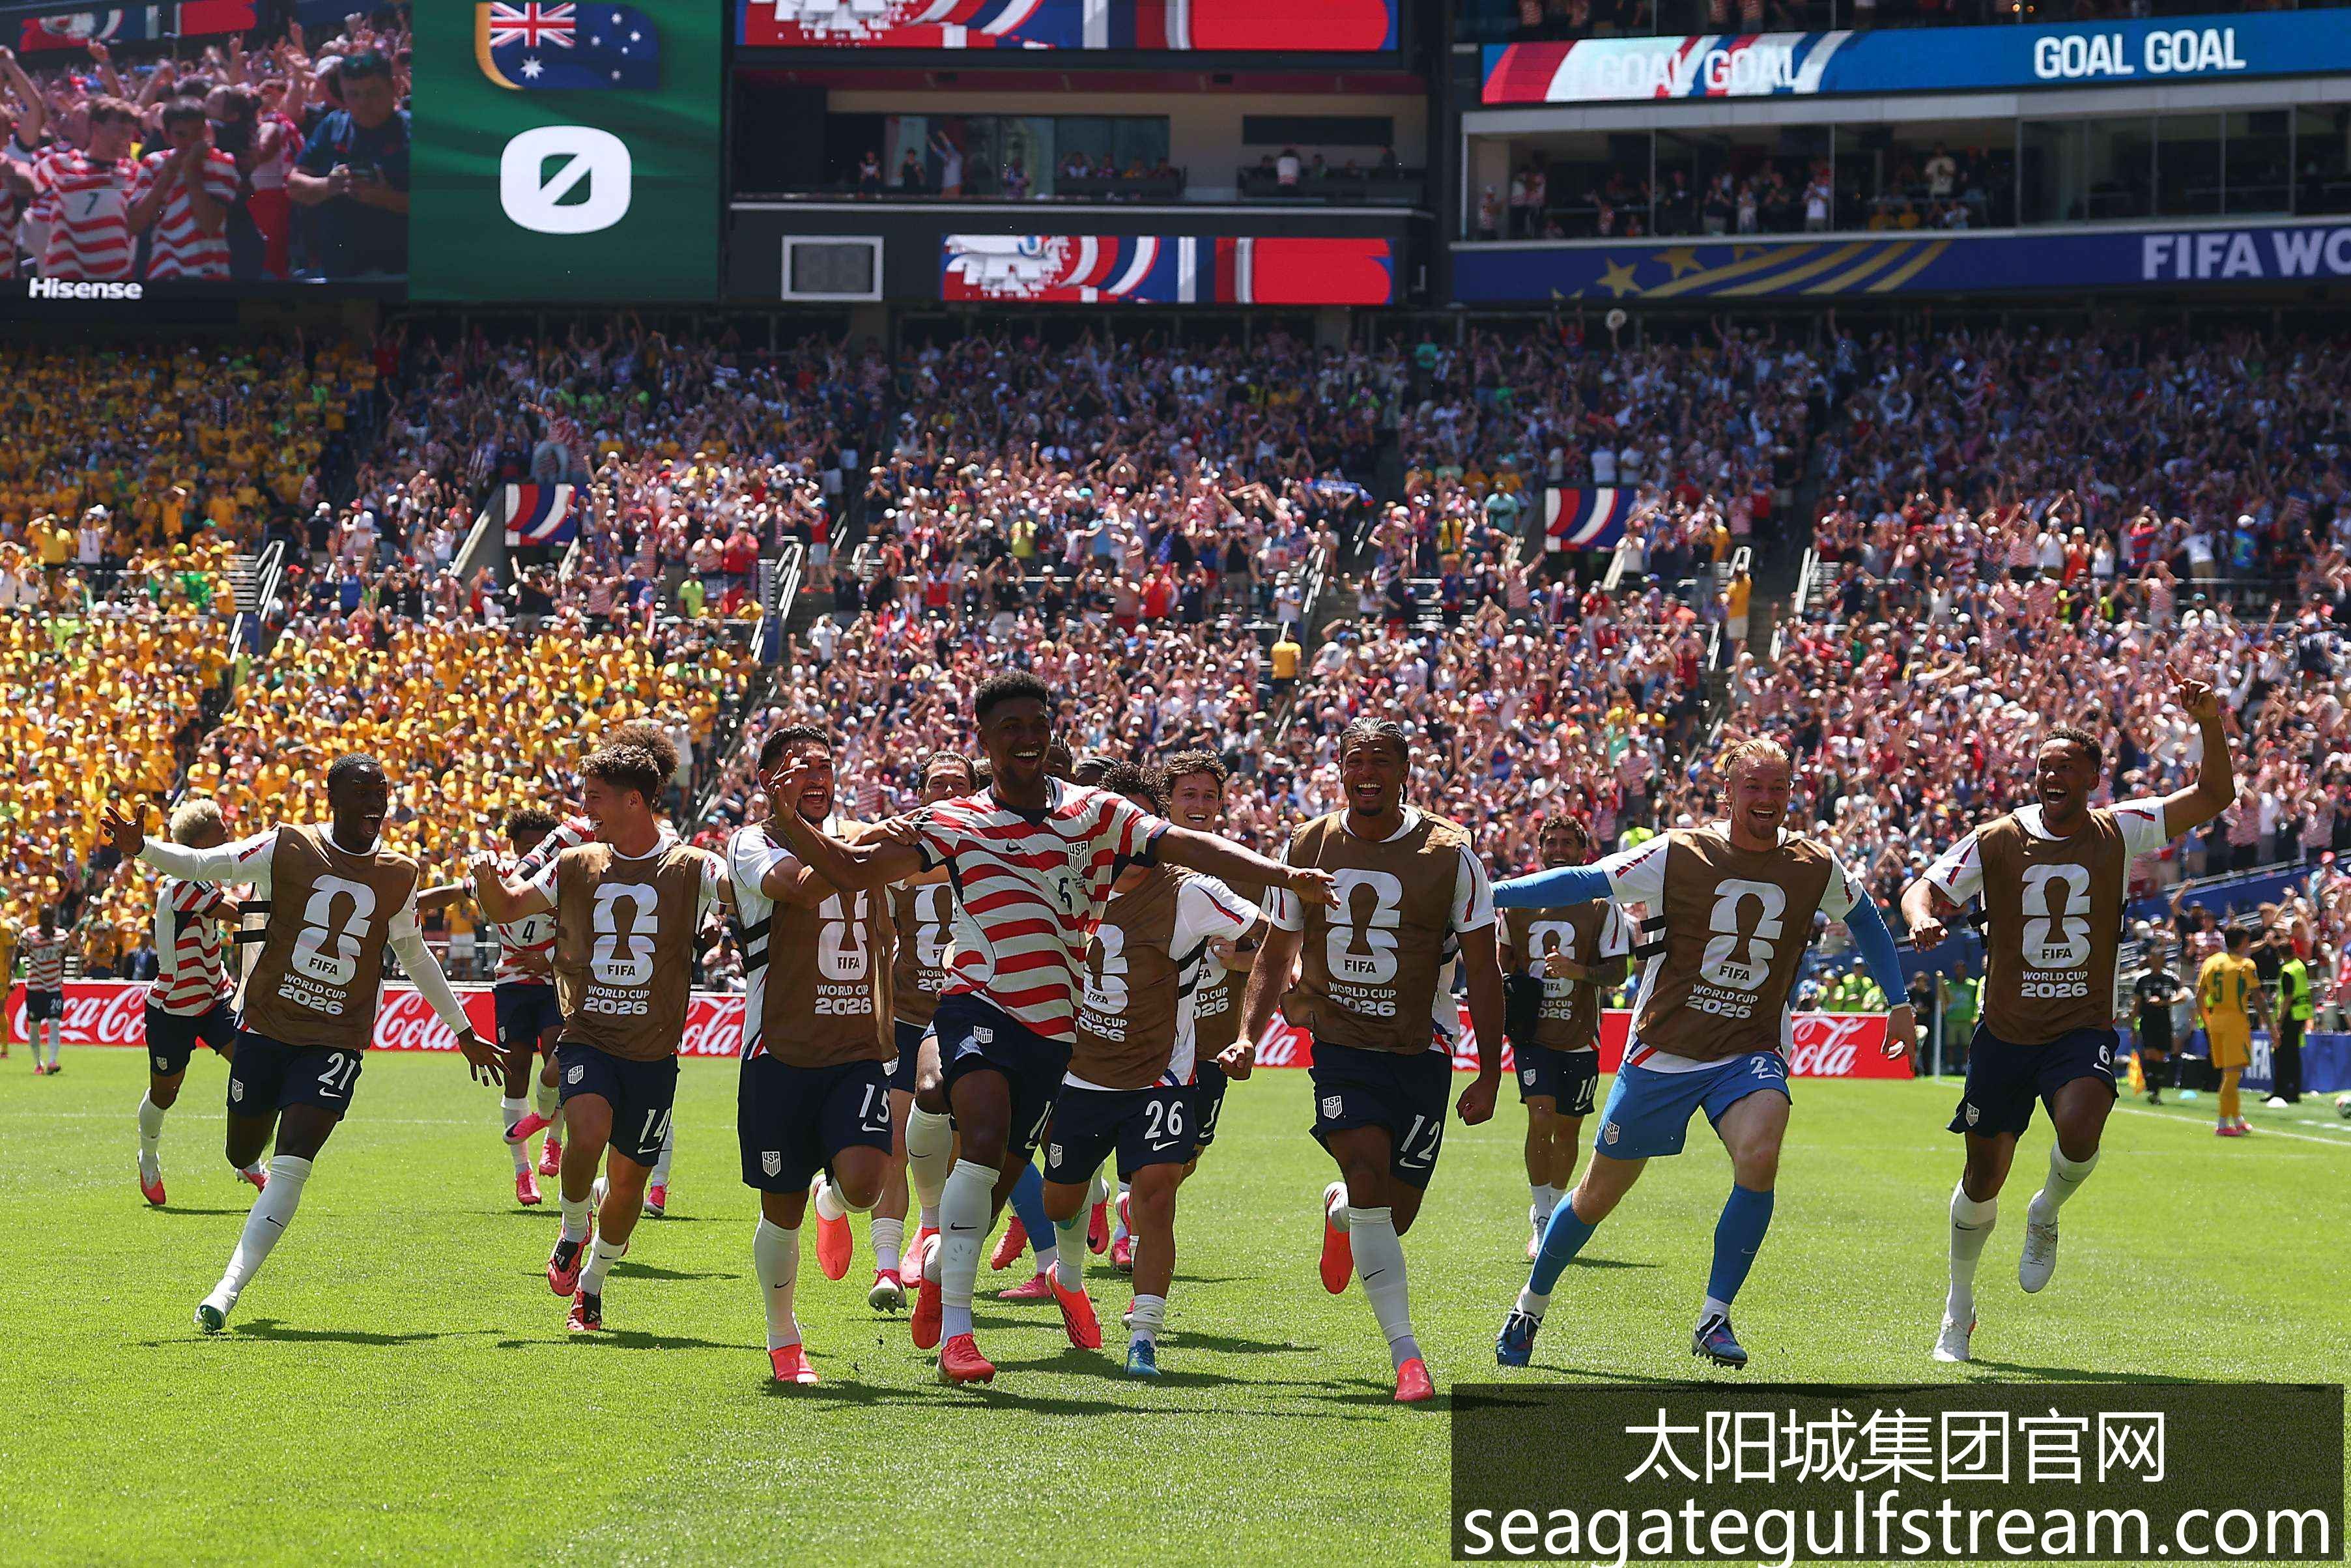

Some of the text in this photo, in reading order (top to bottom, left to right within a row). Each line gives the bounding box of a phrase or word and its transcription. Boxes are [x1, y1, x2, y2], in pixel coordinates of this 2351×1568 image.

[2035, 28, 2247, 79] GOAL GOAL
[1705, 45, 1804, 90] GOAL
[500, 126, 631, 234] 0
[2143, 233, 2264, 279] FIFA
[29, 277, 143, 299] Hisense
[1068, 841, 1087, 857] USA
[522, 920, 535, 944] 4
[837, 956, 860, 969] FIFA
[2042, 948, 2073, 959] FIFA
[309, 957, 338, 976] FIFA
[607, 964, 636, 976] FIFA
[1345, 959, 1377, 974] FIFA
[1720, 965, 1750, 981] FIFA
[2023, 971, 2088, 981] WORLD CUP
[284, 973, 347, 1000] WORLD CUP
[588, 985, 651, 999] WORLD CUP
[817, 984, 869, 996] WORLD CUP
[918, 978, 945, 991] 20
[1210, 986, 1229, 999] CUP
[1329, 981, 1397, 999] WORLD CUP
[1694, 984, 1758, 1004] WORLD CUP
[2021, 982, 2088, 999] 2026
[278, 984, 345, 1016] 2026
[583, 996, 648, 1015] 2026
[815, 997, 872, 1016] 2026
[1685, 995, 1752, 1019] 2026
[1081, 1007, 1128, 1028] ORLD CUP
[1538, 1008, 1572, 1020] 026
[1078, 1016, 1125, 1042] 026
[2099, 1044, 2110, 1066] 6
[318, 1052, 356, 1091] 21
[1576, 1075, 1596, 1104] 10
[859, 1083, 889, 1123] 15
[1323, 1097, 1341, 1107] USA
[640, 1107, 670, 1143] 14
[1145, 1101, 1183, 1140] 26
[1400, 1114, 1440, 1161] 12
[763, 1152, 779, 1162] USA
